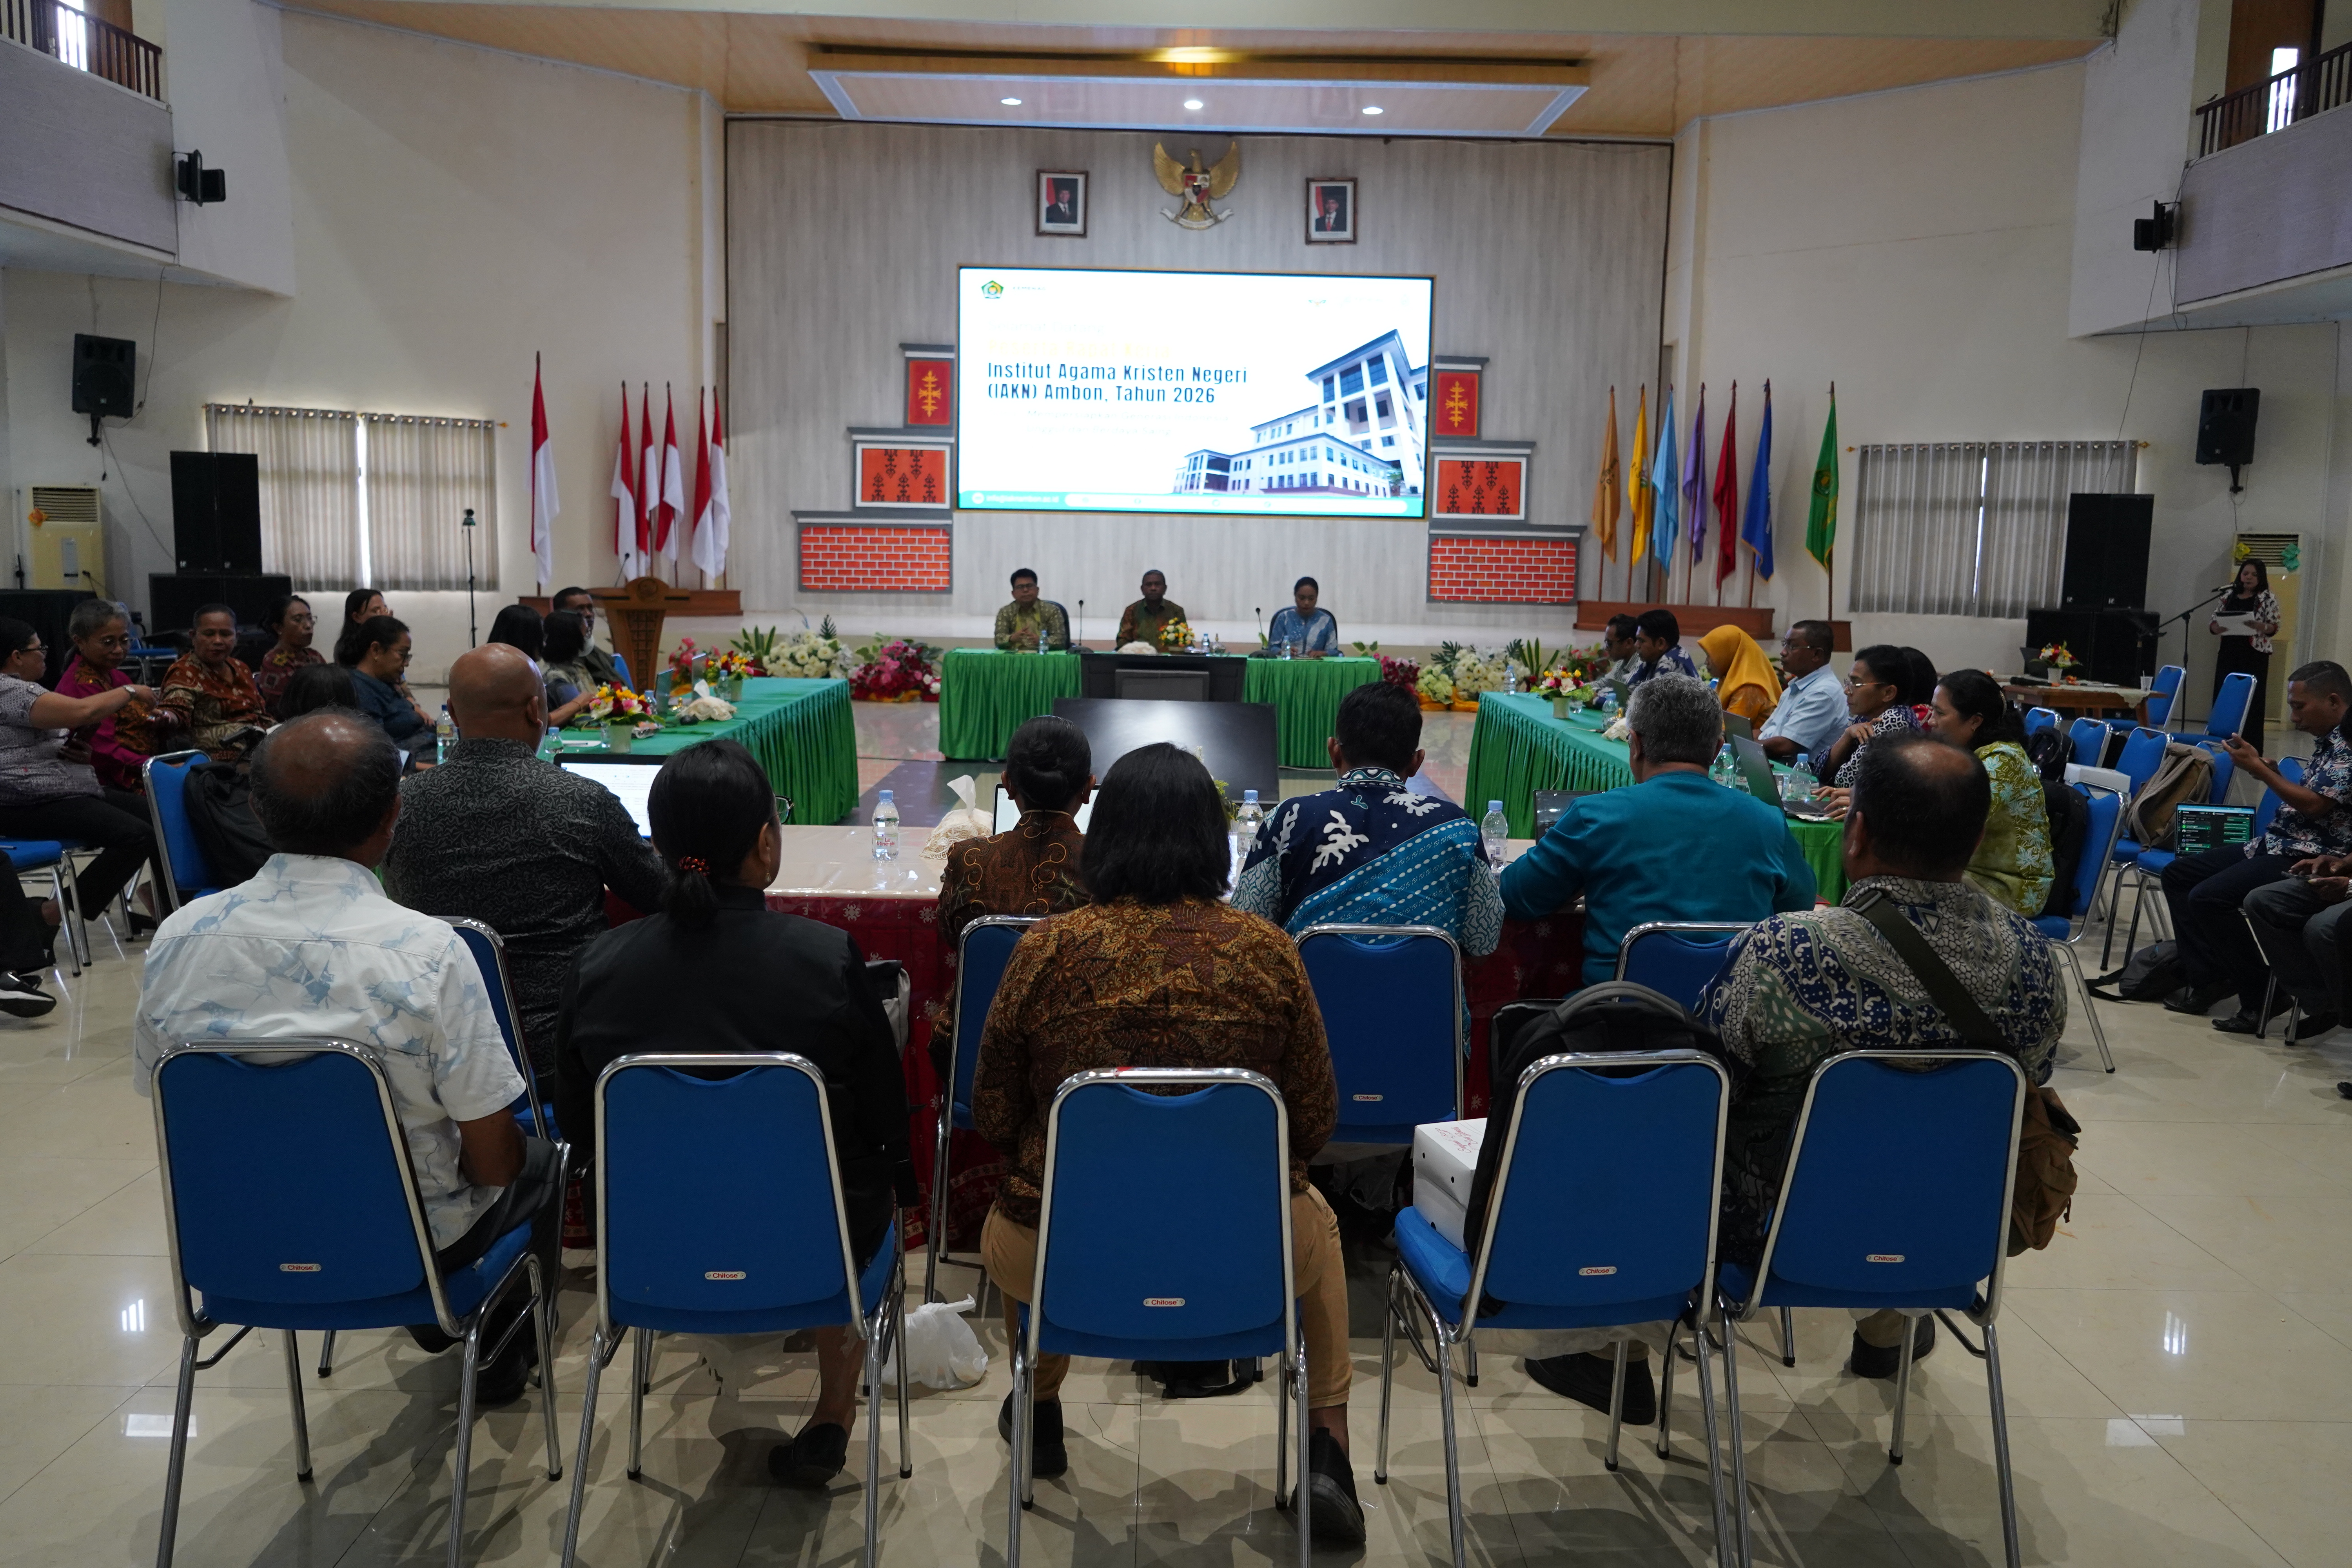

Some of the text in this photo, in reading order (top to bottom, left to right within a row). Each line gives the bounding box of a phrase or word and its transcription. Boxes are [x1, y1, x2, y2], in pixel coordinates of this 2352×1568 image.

[989, 339, 1058, 355] Peserta
[1066, 341, 1116, 358] Rapat
[988, 362, 1247, 385] Institut Agama Kristen Negeri
[988, 383, 1214, 403] (IAKN) Ambon, Tahun 2026
